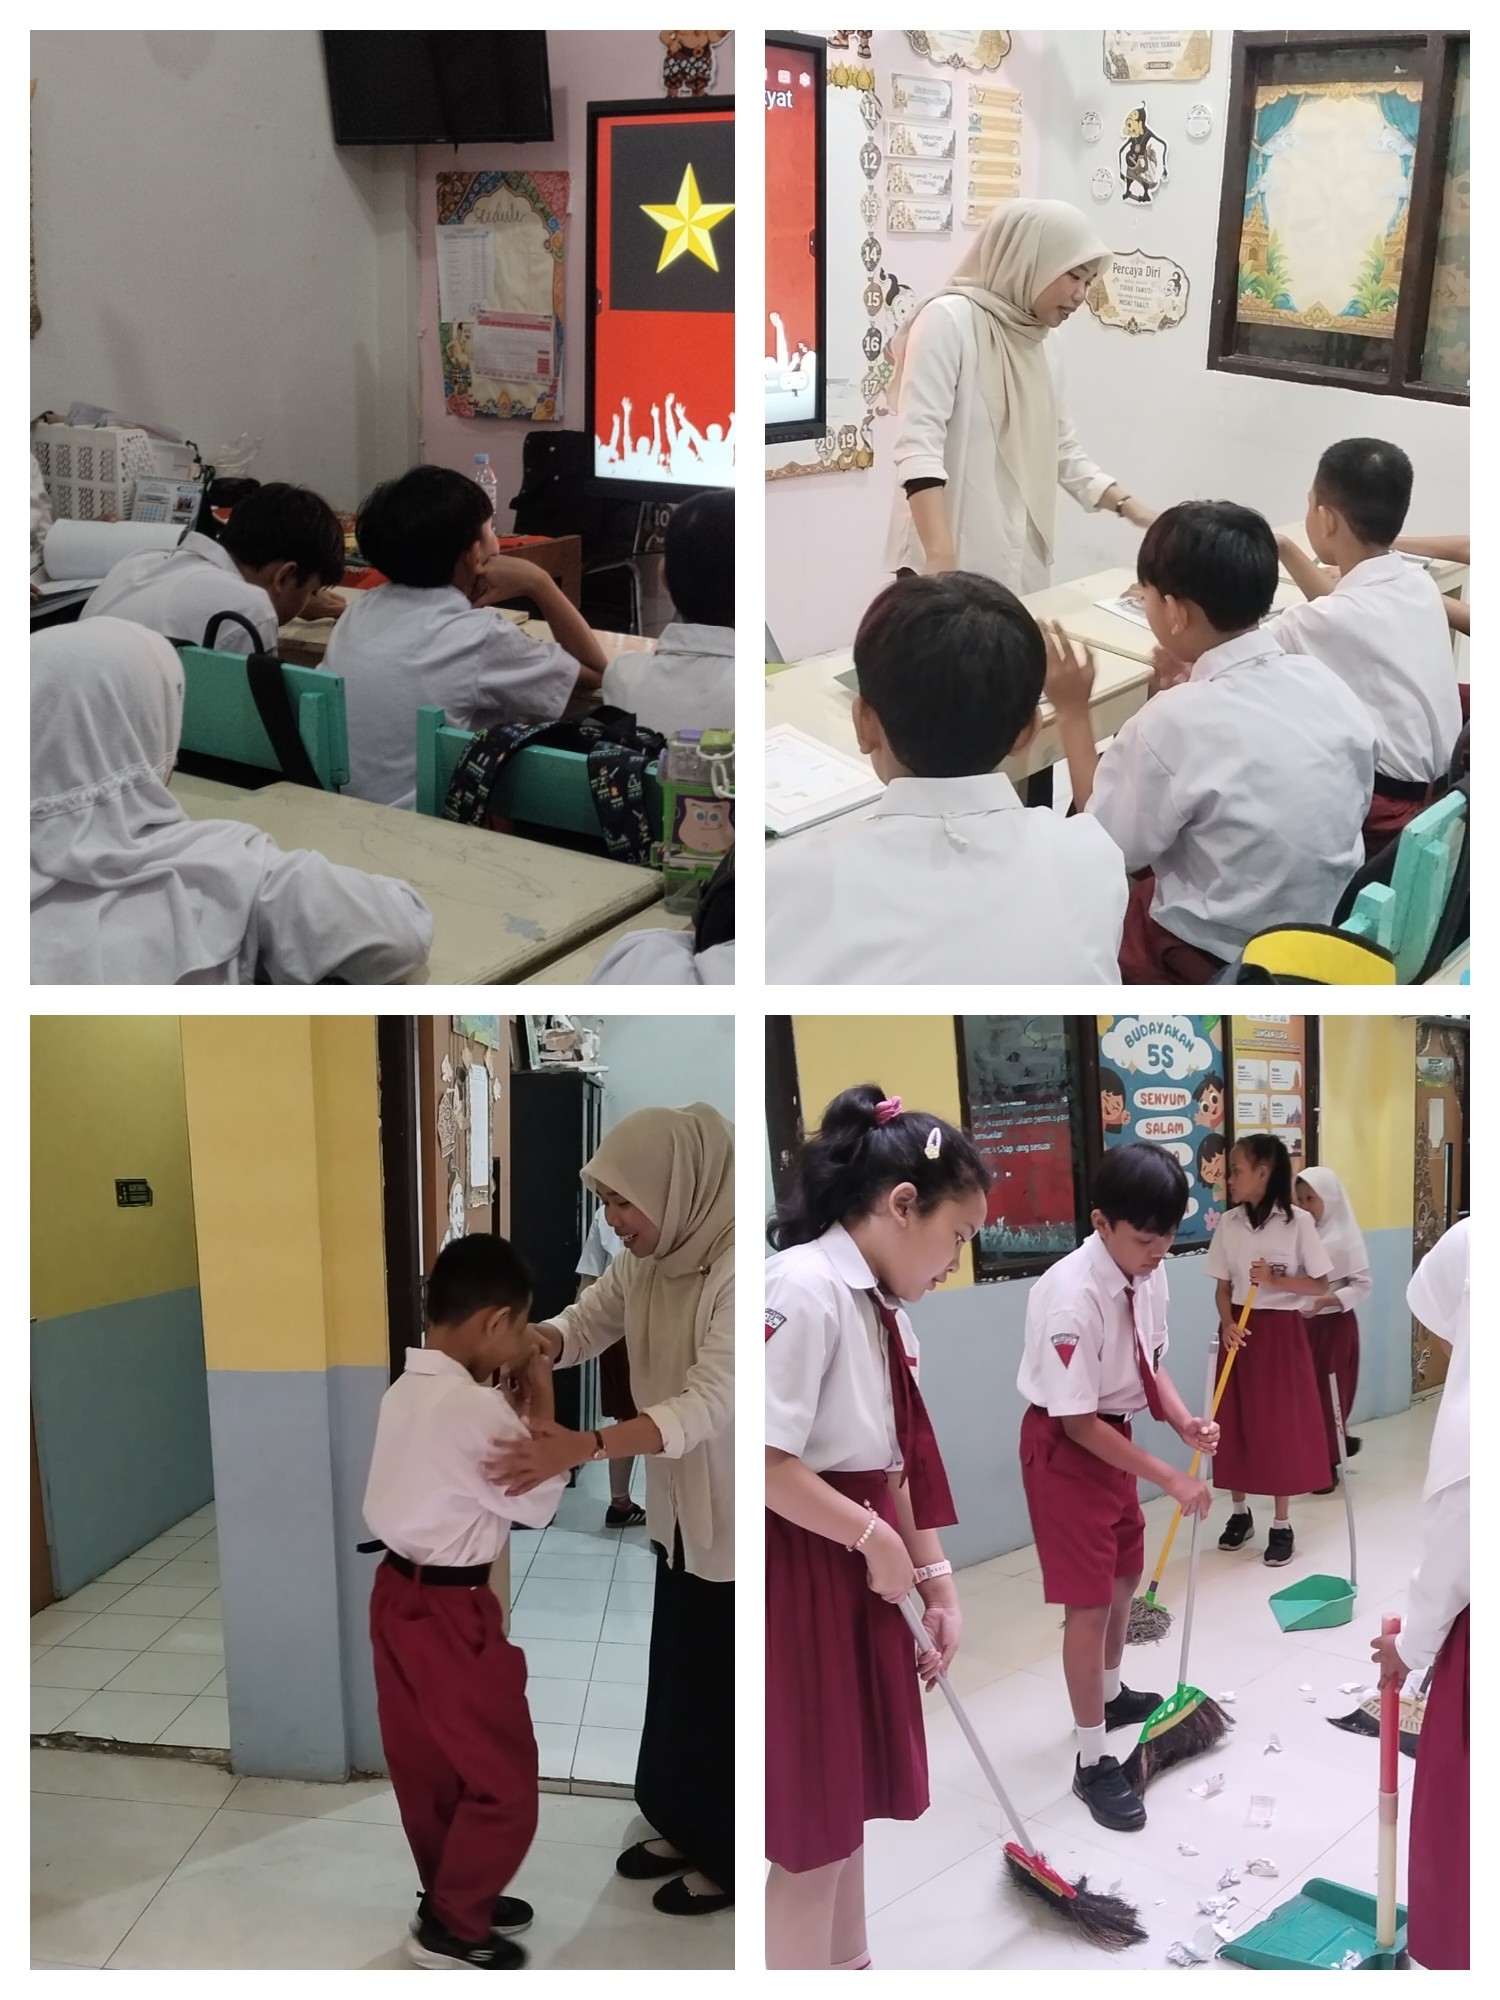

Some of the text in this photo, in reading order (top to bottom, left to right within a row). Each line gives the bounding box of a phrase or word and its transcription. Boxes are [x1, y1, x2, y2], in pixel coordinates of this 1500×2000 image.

[863, 103, 877, 121] 11
[863, 152, 878, 169] 12
[864, 201, 878, 216] 13
[864, 246, 878, 261] 14
[1112, 262, 1161, 278] Percaya Diri
[866, 291, 880, 306] 15
[865, 336, 880, 351] 16
[863, 380, 878, 395] 17
[817, 435, 834, 452] 20
[840, 432, 855, 448] 19
[654, 509, 670, 527] 10
[1124, 1021, 1195, 1053] BUDAYAKAN
[1147, 1043, 1174, 1068] 5S
[1140, 1092, 1187, 1105] SENYUM
[1145, 1122, 1184, 1135] SALAM
